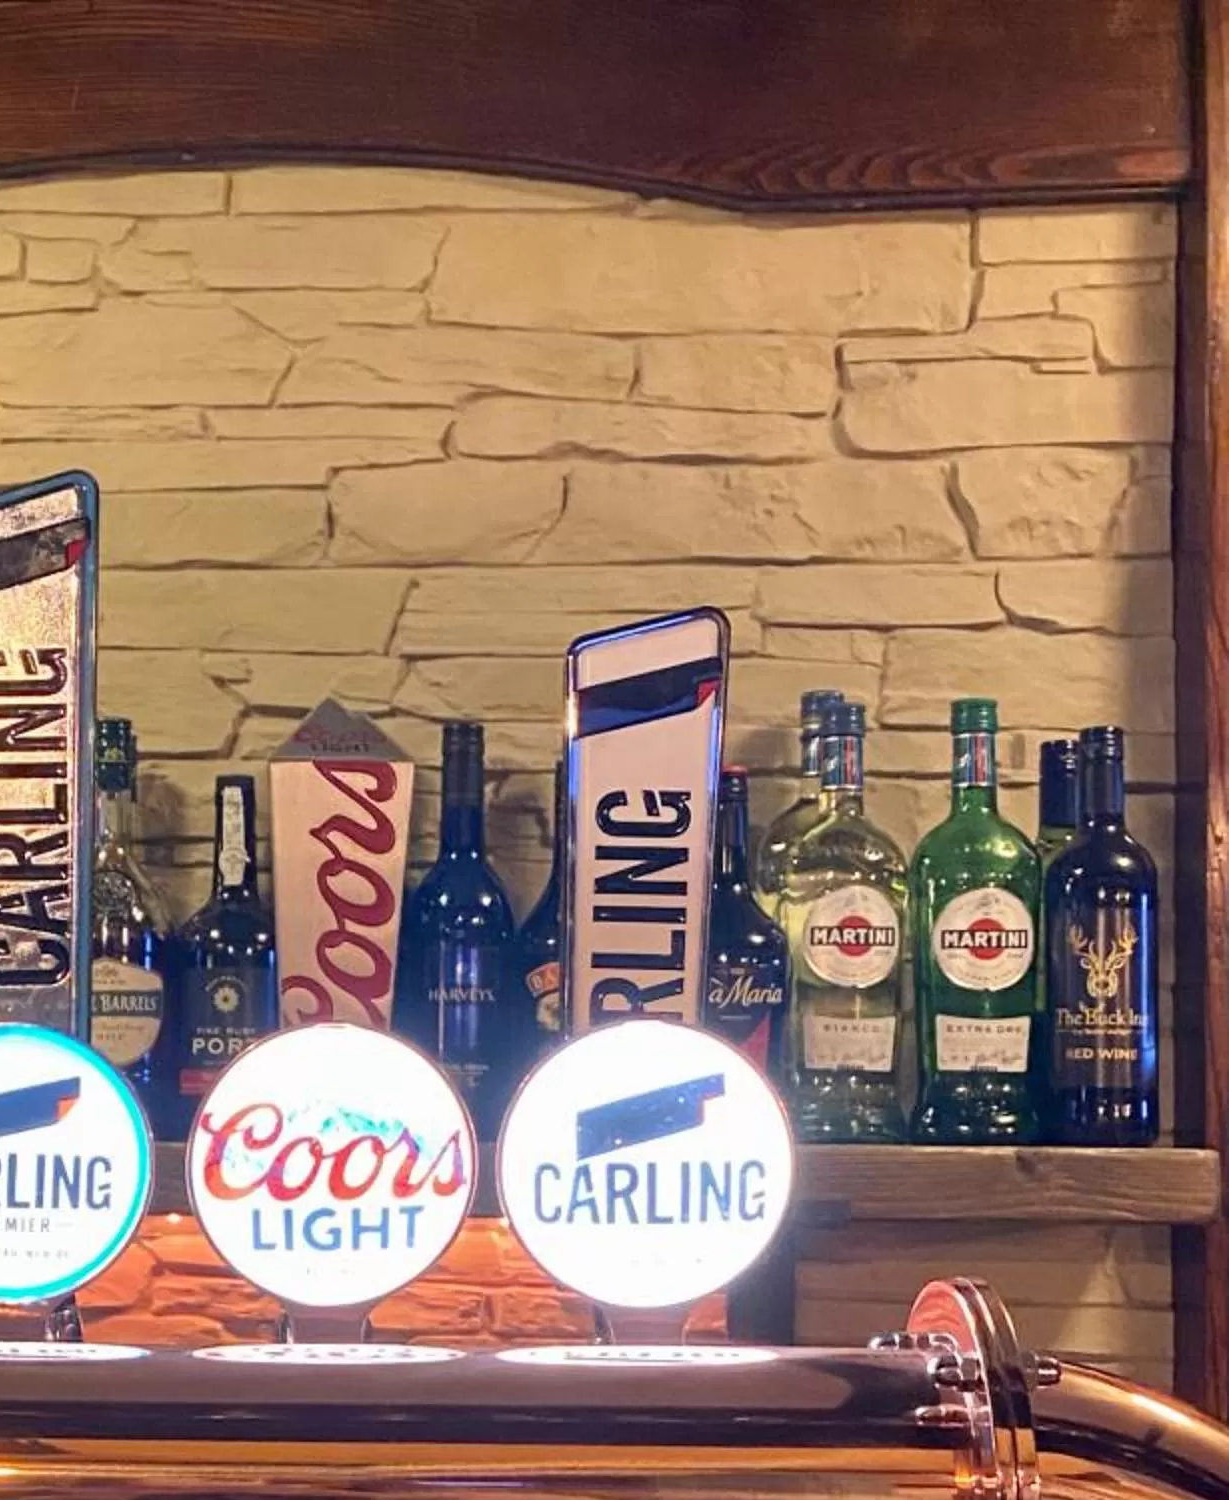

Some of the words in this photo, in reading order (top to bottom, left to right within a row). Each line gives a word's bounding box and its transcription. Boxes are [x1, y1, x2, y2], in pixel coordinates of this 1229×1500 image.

[589, 789, 692, 1027] RLING
[812, 928, 893, 946] MARTINI
[943, 931, 1027, 948] MARTINI
[100, 993, 158, 1013] BARRELS
[427, 987, 497, 1003] HARVEYS
[1096, 1047, 1138, 1061] WINE
[202, 1103, 468, 1203] Coors
[532, 1159, 767, 1225] CARLING
[252, 1205, 426, 1253] LIGHT
